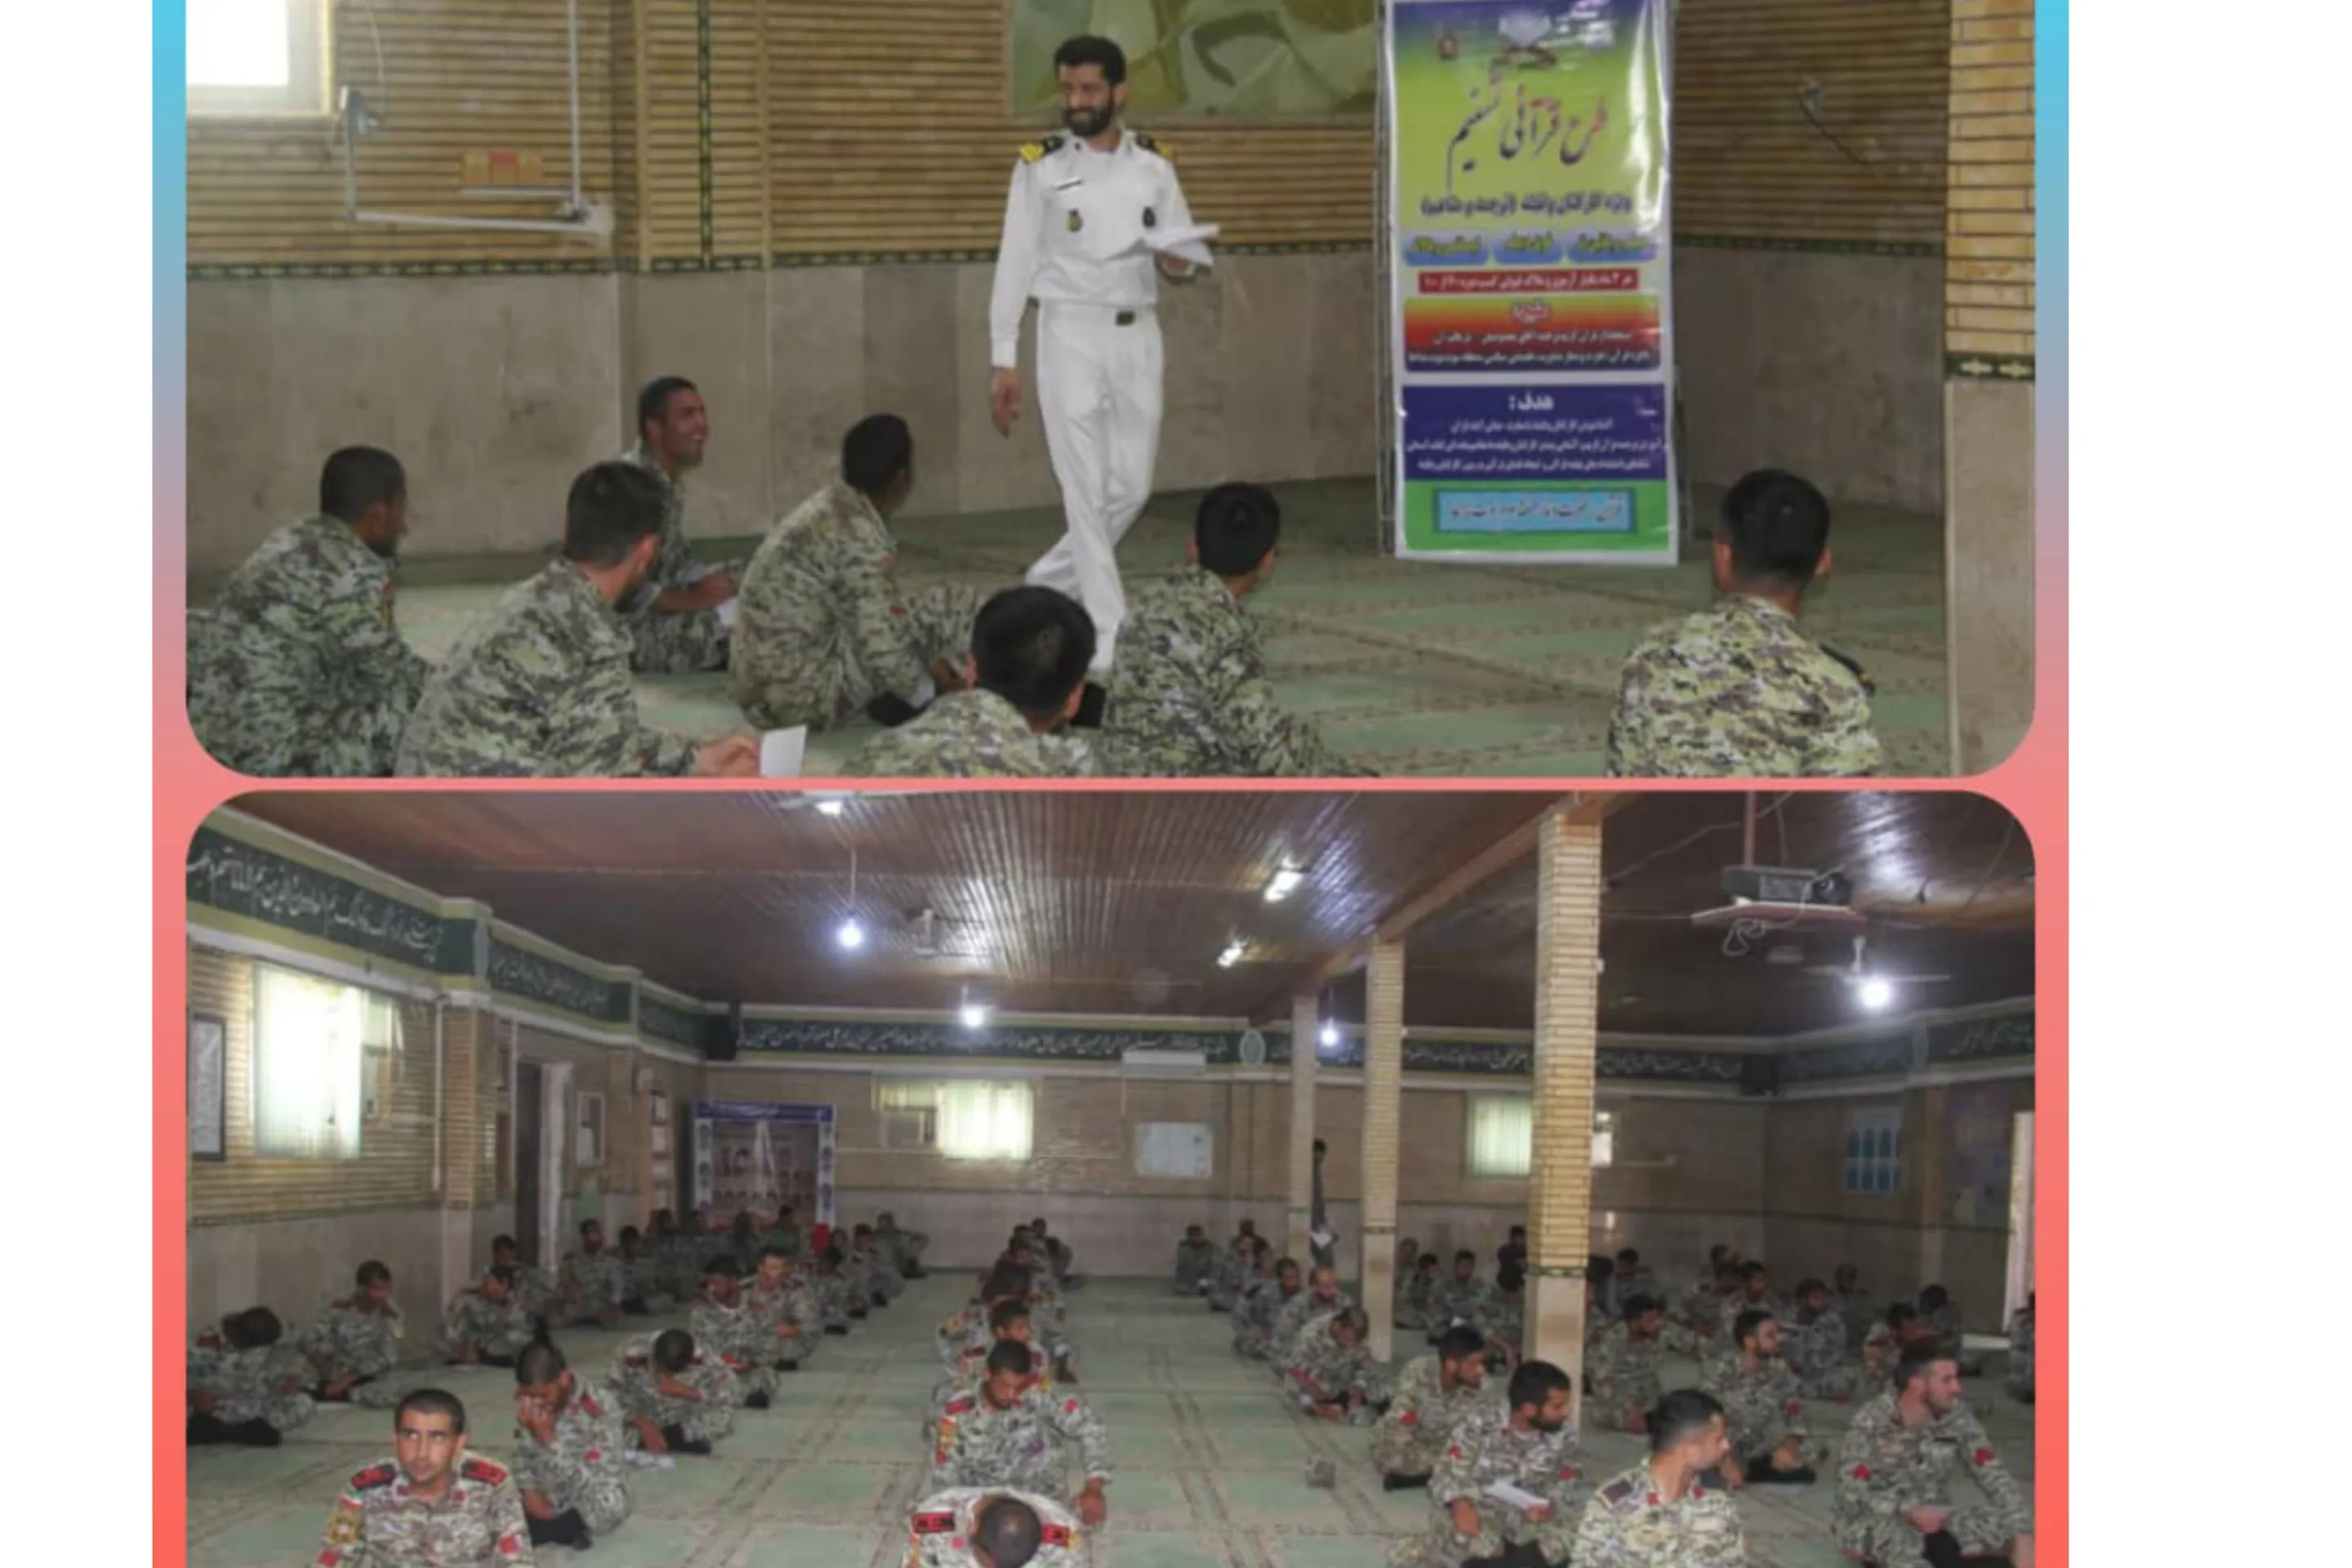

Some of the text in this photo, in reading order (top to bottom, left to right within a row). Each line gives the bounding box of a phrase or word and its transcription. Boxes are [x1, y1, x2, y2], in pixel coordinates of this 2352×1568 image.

[1445, 74, 1607, 194] طرح قرآنی تسنیم
